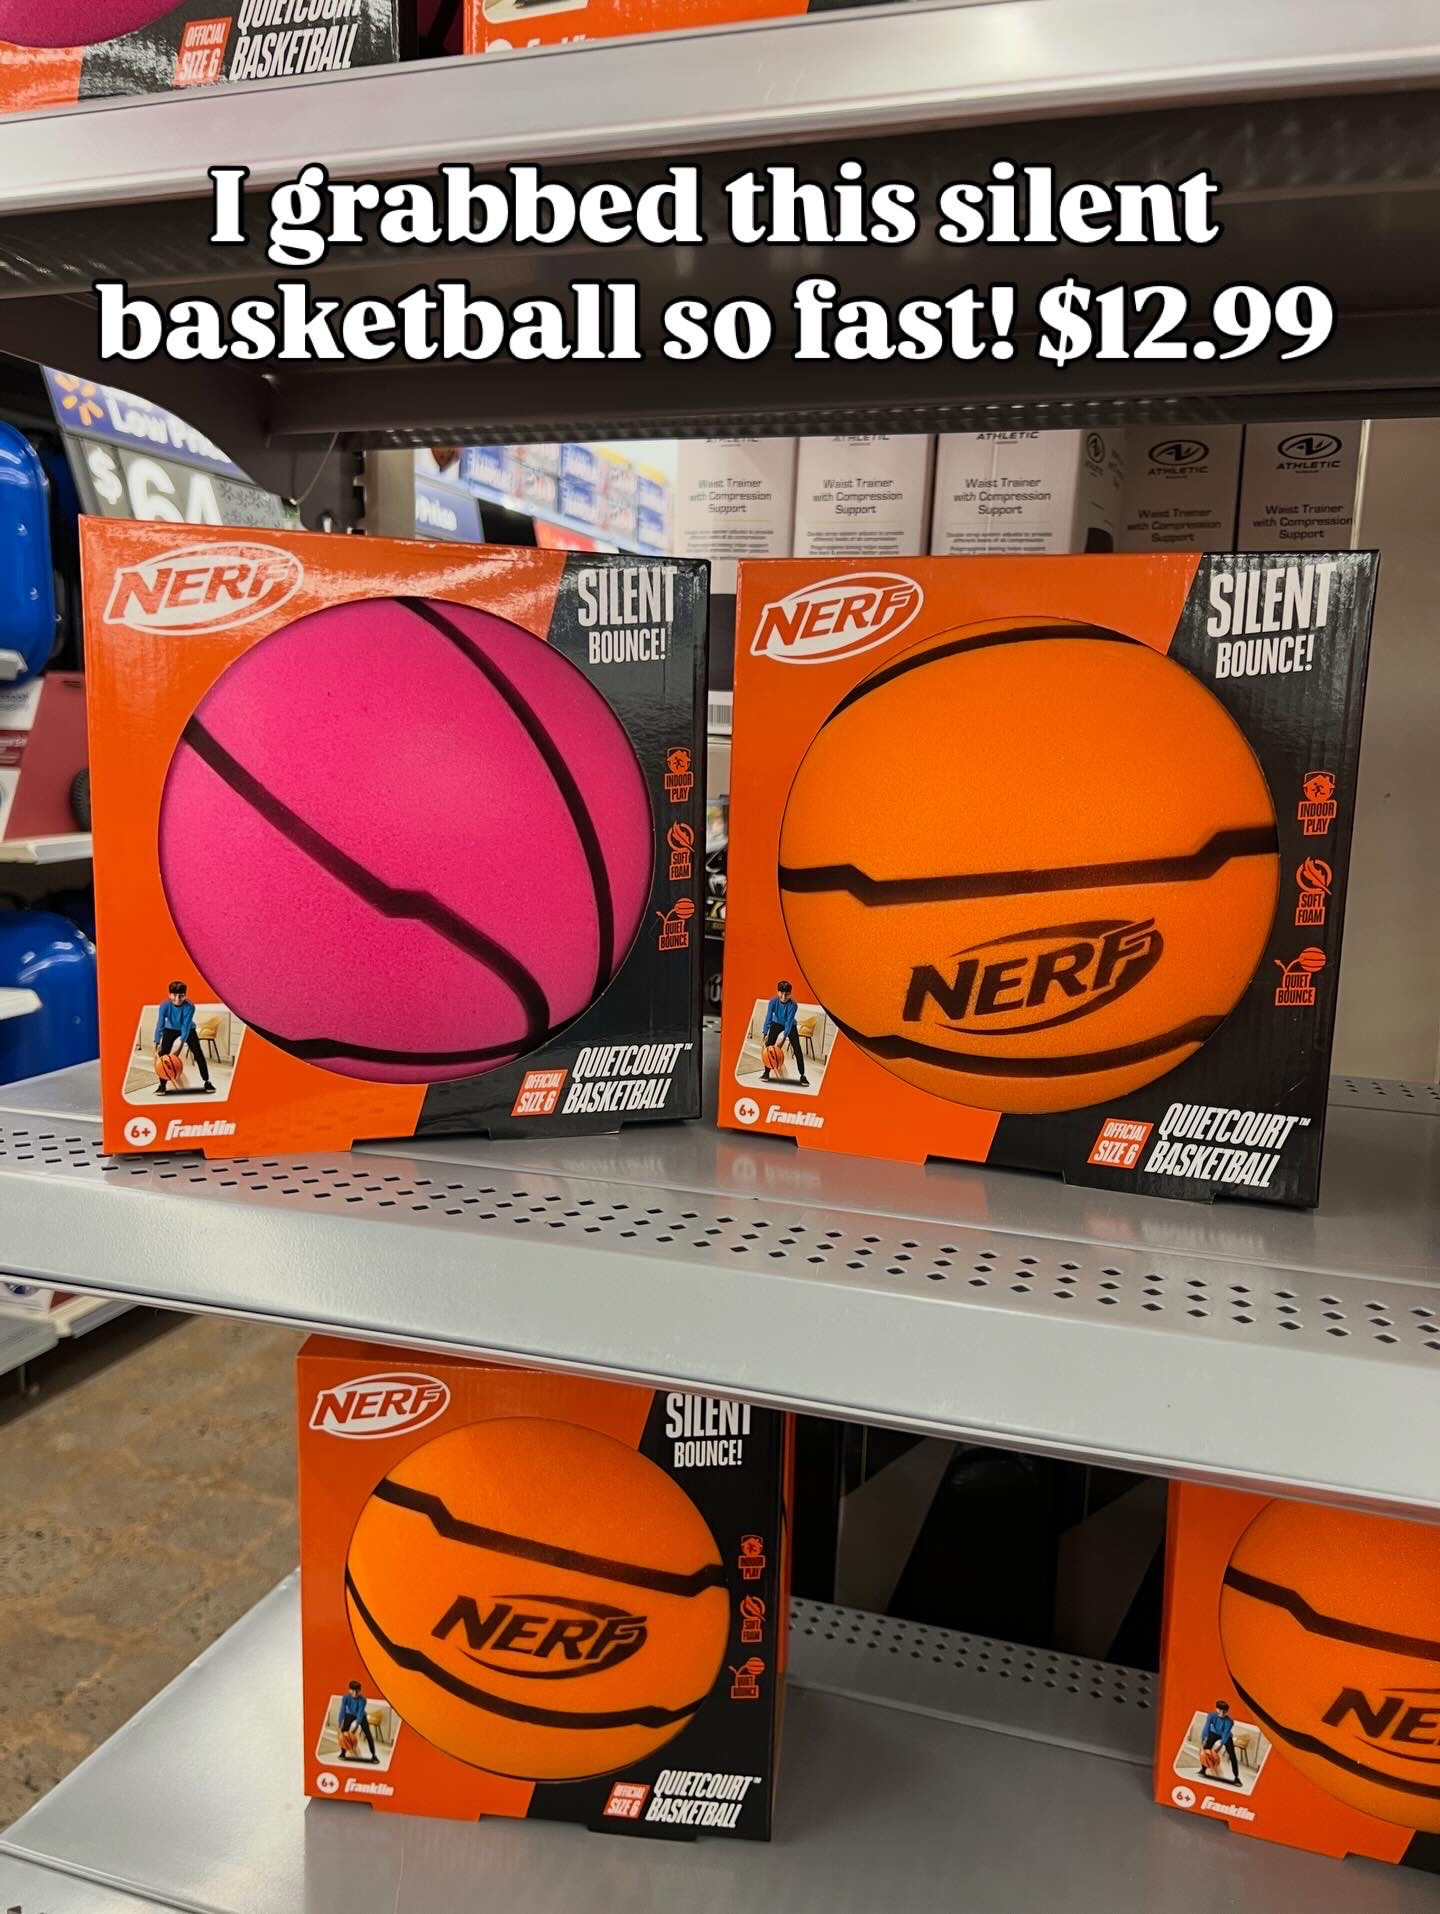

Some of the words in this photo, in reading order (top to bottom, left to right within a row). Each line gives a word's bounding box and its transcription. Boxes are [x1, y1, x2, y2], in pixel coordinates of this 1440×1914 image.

[185, 23, 227, 47] OFFICIAL
[229, 23, 358, 80] BASKETBALL
[181, 50, 211, 80] SIZE
[208, 48, 221, 79] 6
[976, 431, 1039, 440] ATHLETIC
[1148, 466, 1209, 475] ATHLETIC
[1276, 460, 1341, 470] ATHLETIC
[856, 478, 895, 488] Trainer
[965, 478, 998, 488] Waist
[1000, 477, 1042, 488] Trainer
[709, 491, 772, 503] Compression
[836, 491, 904, 503] Compression
[953, 492, 977, 502] with
[978, 491, 1052, 503] Compression
[708, 504, 747, 515] Support
[835, 504, 878, 516] Support
[977, 504, 1024, 517] Support
[1265, 505, 1299, 515] Waist
[1302, 504, 1345, 514] Trainer
[1252, 517, 1277, 528] with
[1279, 516, 1353, 529] Compression
[1151, 532, 1196, 544] Support
[1279, 528, 1326, 541] Support
[106, 547, 301, 628] NERF
[577, 565, 678, 628] SILENT
[1206, 562, 1338, 639] SILENT
[752, 580, 921, 656] NERF
[588, 627, 667, 666] BOUNCE!
[1215, 634, 1315, 679] BOUNCE!
[666, 773, 693, 788] INDOOR
[671, 787, 689, 801] PLAY
[1299, 801, 1335, 818] INDOOR
[1305, 818, 1328, 833] PLAY
[672, 851, 689, 865] SOFT
[670, 865, 691, 879] FOAM
[1300, 893, 1323, 908] SOFT
[1297, 908, 1323, 923] FOAM
[664, 921, 684, 936] QUIET
[660, 934, 688, 949] BOUNCE
[903, 917, 1160, 1024] NERF
[1284, 974, 1310, 989] QUIET
[1277, 988, 1314, 1005] BOUNCE
[524, 1072, 563, 1090] OFFICIAL
[517, 1091, 545, 1114] SIZE
[542, 1090, 557, 1112] 6
[562, 1078, 673, 1115] BASKETBALL
[738, 1104, 756, 1117] 6+
[765, 1104, 825, 1129] Franklin
[130, 1125, 151, 1138] 6+
[164, 1119, 237, 1141] Franklin
[1103, 1122, 1147, 1142] OFFICIAL
[1093, 1140, 1126, 1164] SIZE
[1123, 1143, 1140, 1165] 6
[1144, 1140, 1281, 1188] BASKETBALL
[310, 1379, 448, 1431] NERF
[665, 1391, 751, 1439] SILENT
[673, 1439, 743, 1468] BOUNCE!
[431, 1594, 648, 1663] NERF
[1320, 1686, 1440, 1746] NE
[645, 1796, 743, 1829] BASKETBALL
